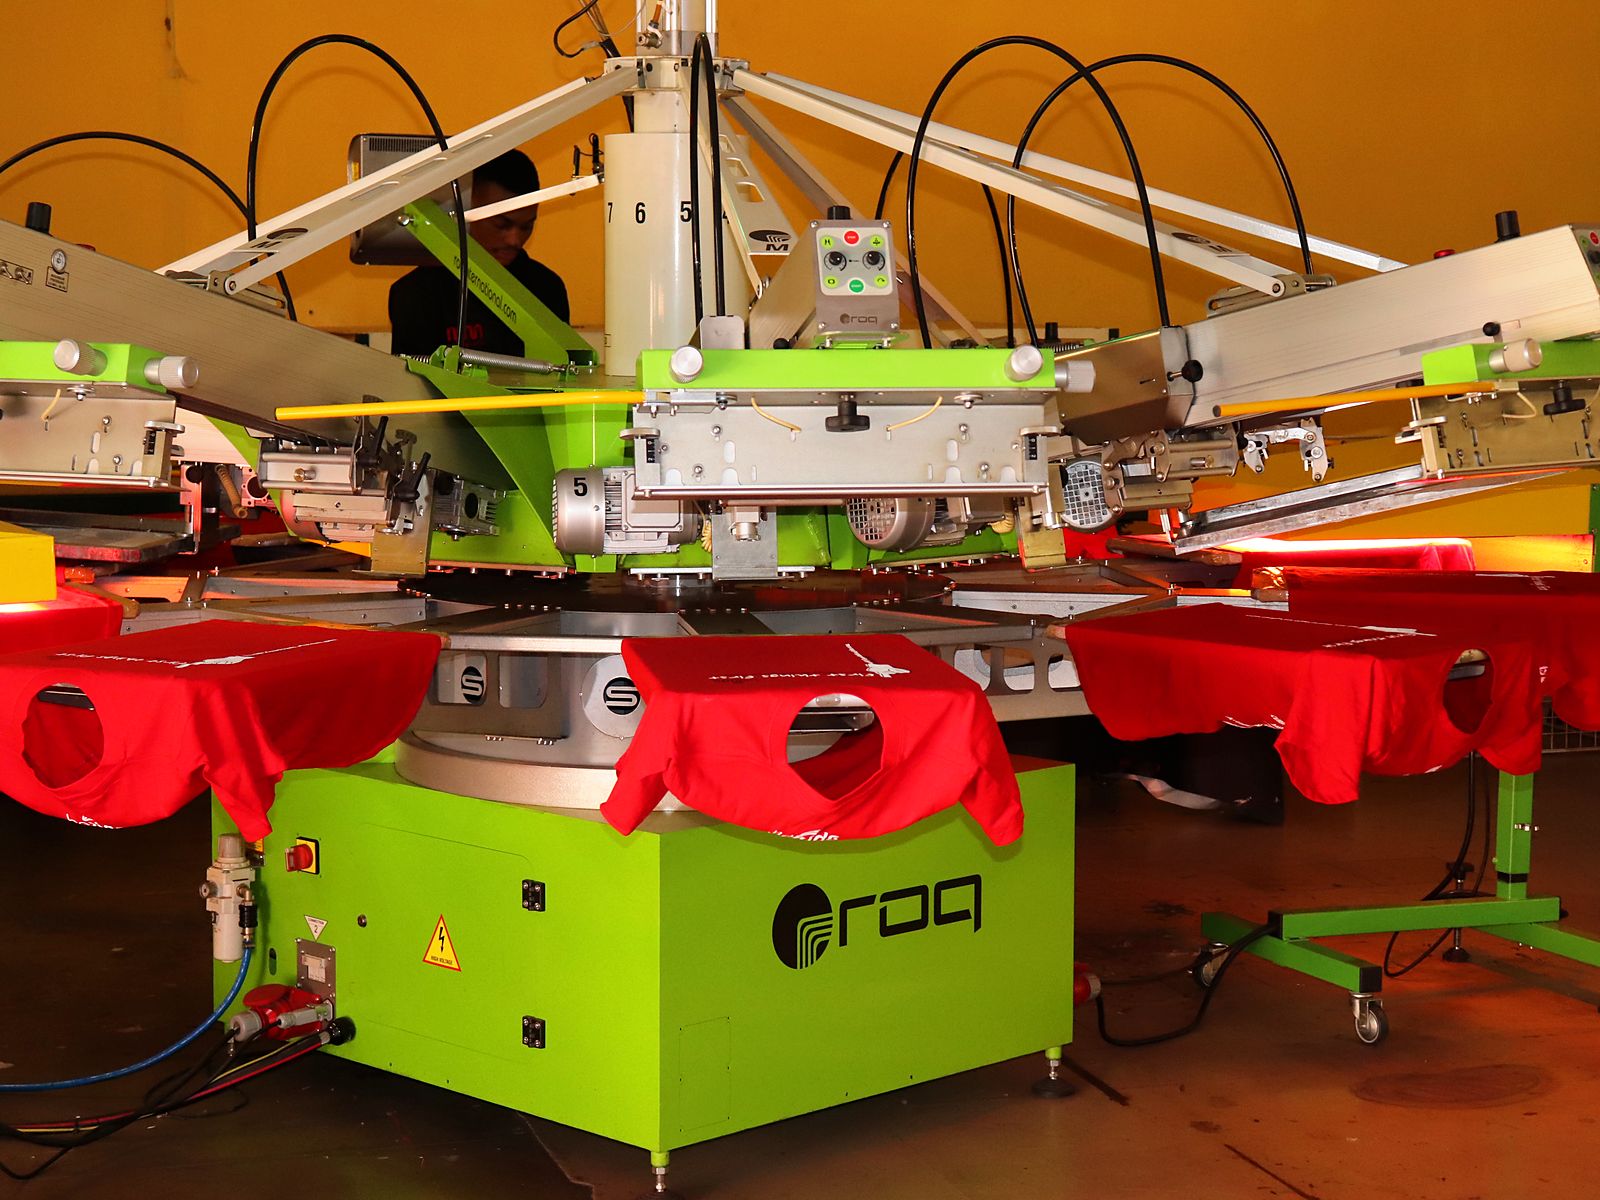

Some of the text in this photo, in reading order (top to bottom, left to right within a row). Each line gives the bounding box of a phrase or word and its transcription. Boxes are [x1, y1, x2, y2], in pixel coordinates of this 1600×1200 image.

[607, 202, 613, 223] 7
[635, 202, 646, 224] 6
[680, 201, 692, 222] 5
[766, 243, 789, 251] M
[453, 255, 518, 323] roternational.com
[573, 477, 588, 497] 5
[839, 874, 982, 947] roq
